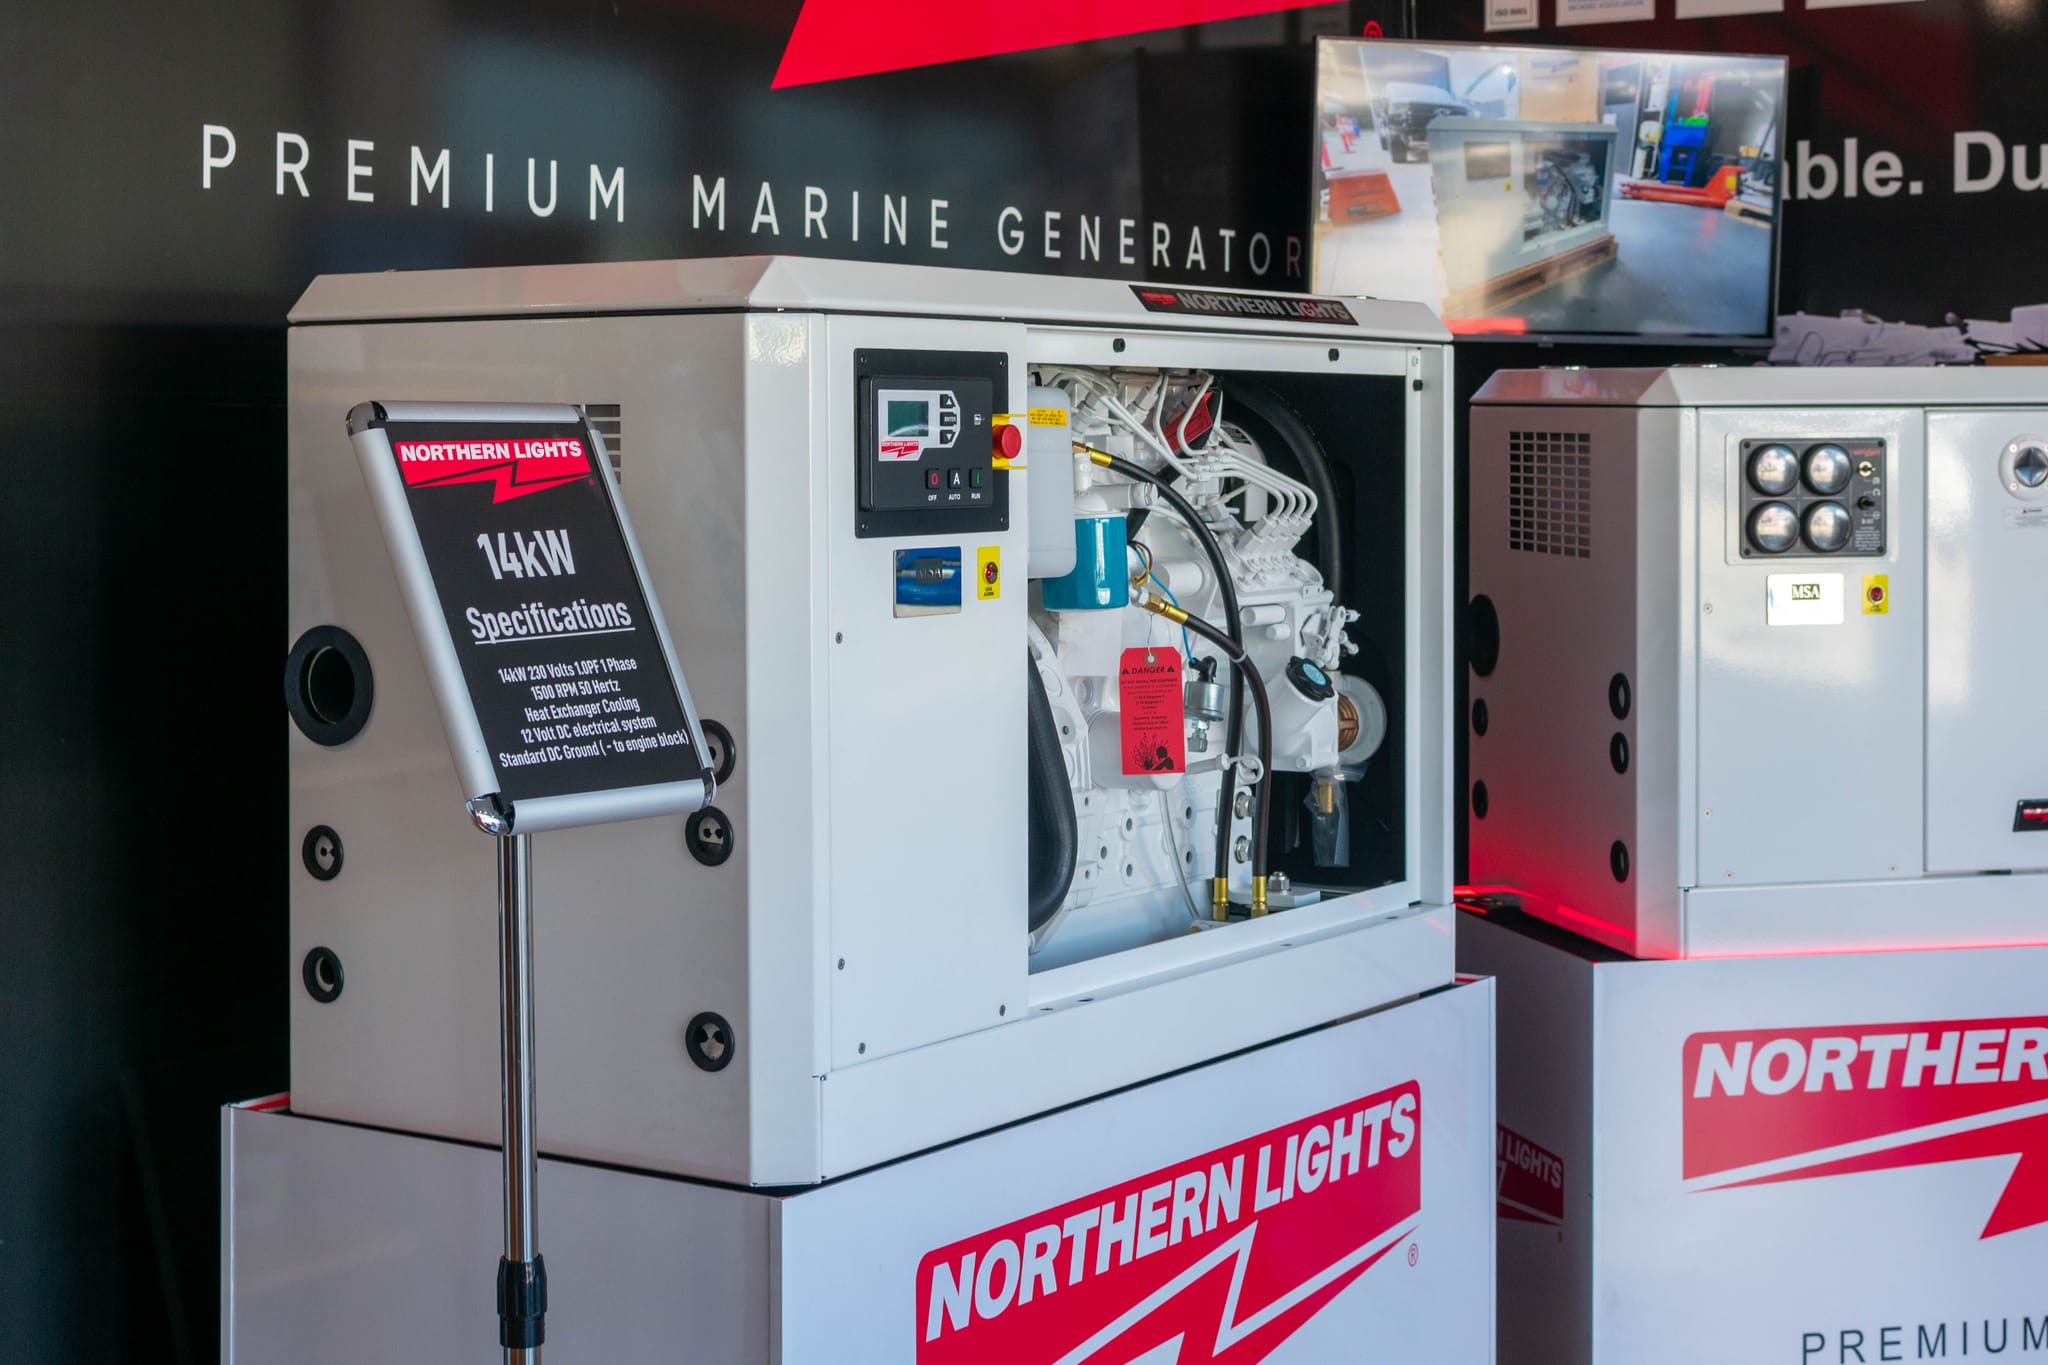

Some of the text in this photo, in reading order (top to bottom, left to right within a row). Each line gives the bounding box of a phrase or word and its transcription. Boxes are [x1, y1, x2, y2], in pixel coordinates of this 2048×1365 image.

[203, 124, 1302, 278] PREMIUM MARINE GENERATOR
[1176, 292, 1350, 320] NORTHERN LIGHTS
[401, 441, 582, 462] NORTHERN LIGHTS
[477, 529, 577, 580] 14kW
[1791, 584, 1820, 600] MSA
[466, 599, 632, 644] Specifications
[498, 657, 637, 683] 14kW 230 Volts 1.0PF 1 Phase
[1131, 666, 1165, 675] DANGER
[531, 678, 621, 701] 1500 RPM 50 Hertz
[524, 697, 640, 722] Heat Exchanger Cooling
[521, 716, 656, 743] 12 Volt DC electrical system
[499, 748, 548, 768] Standard
[546, 746, 563, 761] DC
[562, 741, 600, 760] Ground
[613, 739, 625, 752] to
[625, 736, 658, 753] engine
[657, 728, 689, 747] block)
[1506, 1135, 1562, 1189] LIGHTS
[925, 1093, 1416, 1342] NORTHERN LIGHTS
